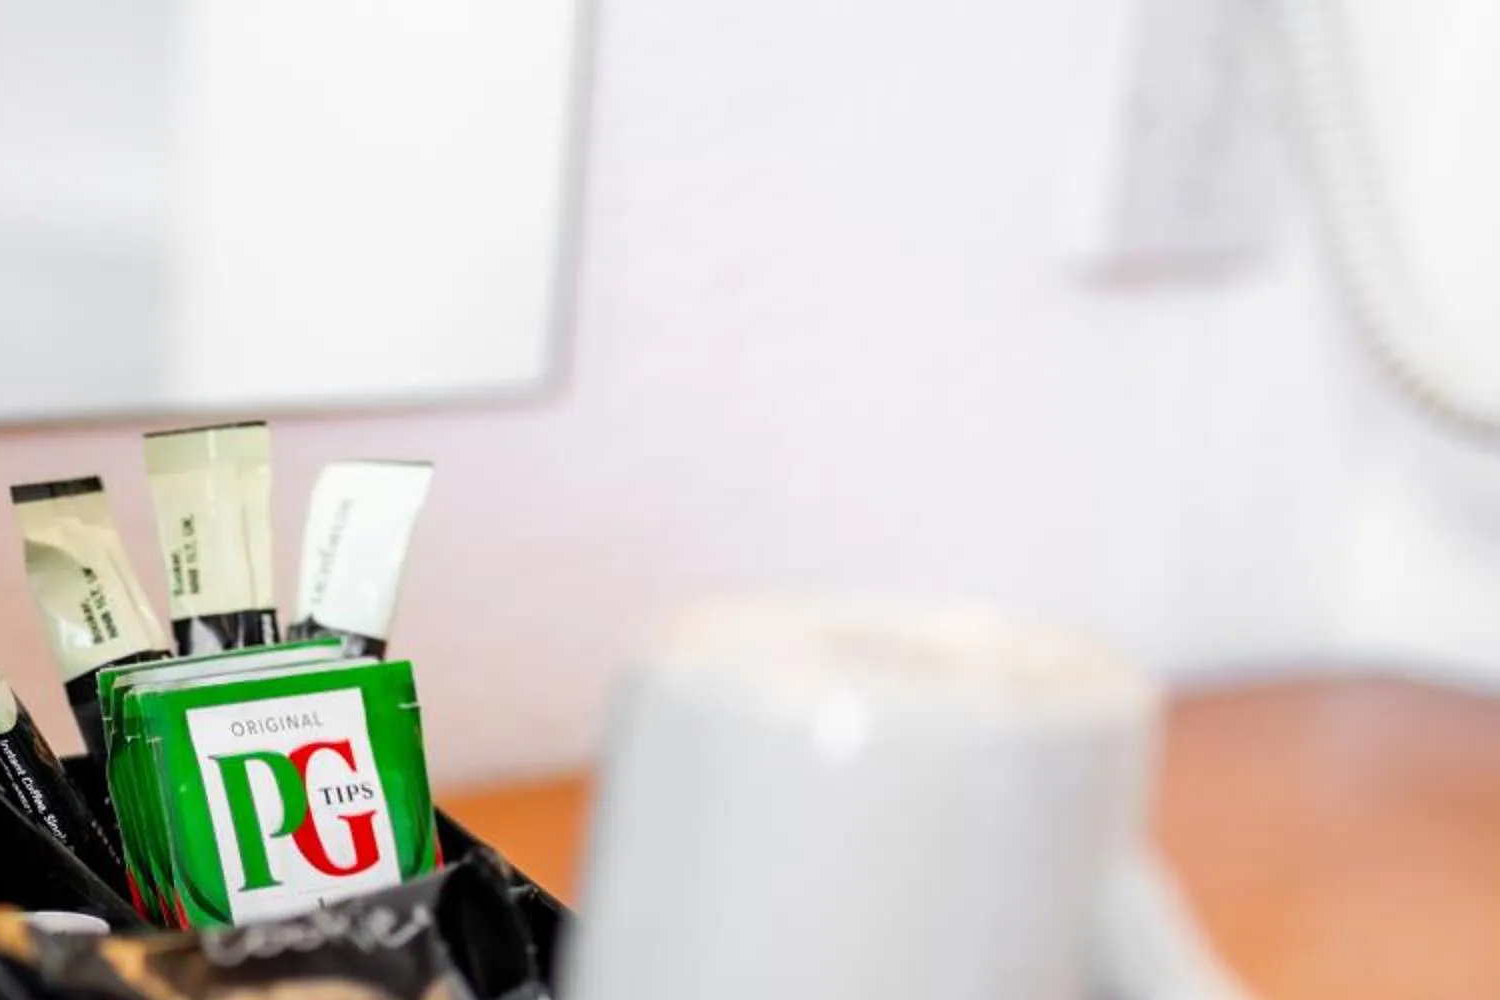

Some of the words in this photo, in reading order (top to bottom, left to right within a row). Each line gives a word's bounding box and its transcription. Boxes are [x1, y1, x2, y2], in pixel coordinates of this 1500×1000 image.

[231, 711, 324, 738] ORIGINAL
[319, 783, 375, 806] TIPS
[207, 738, 380, 892] PG
